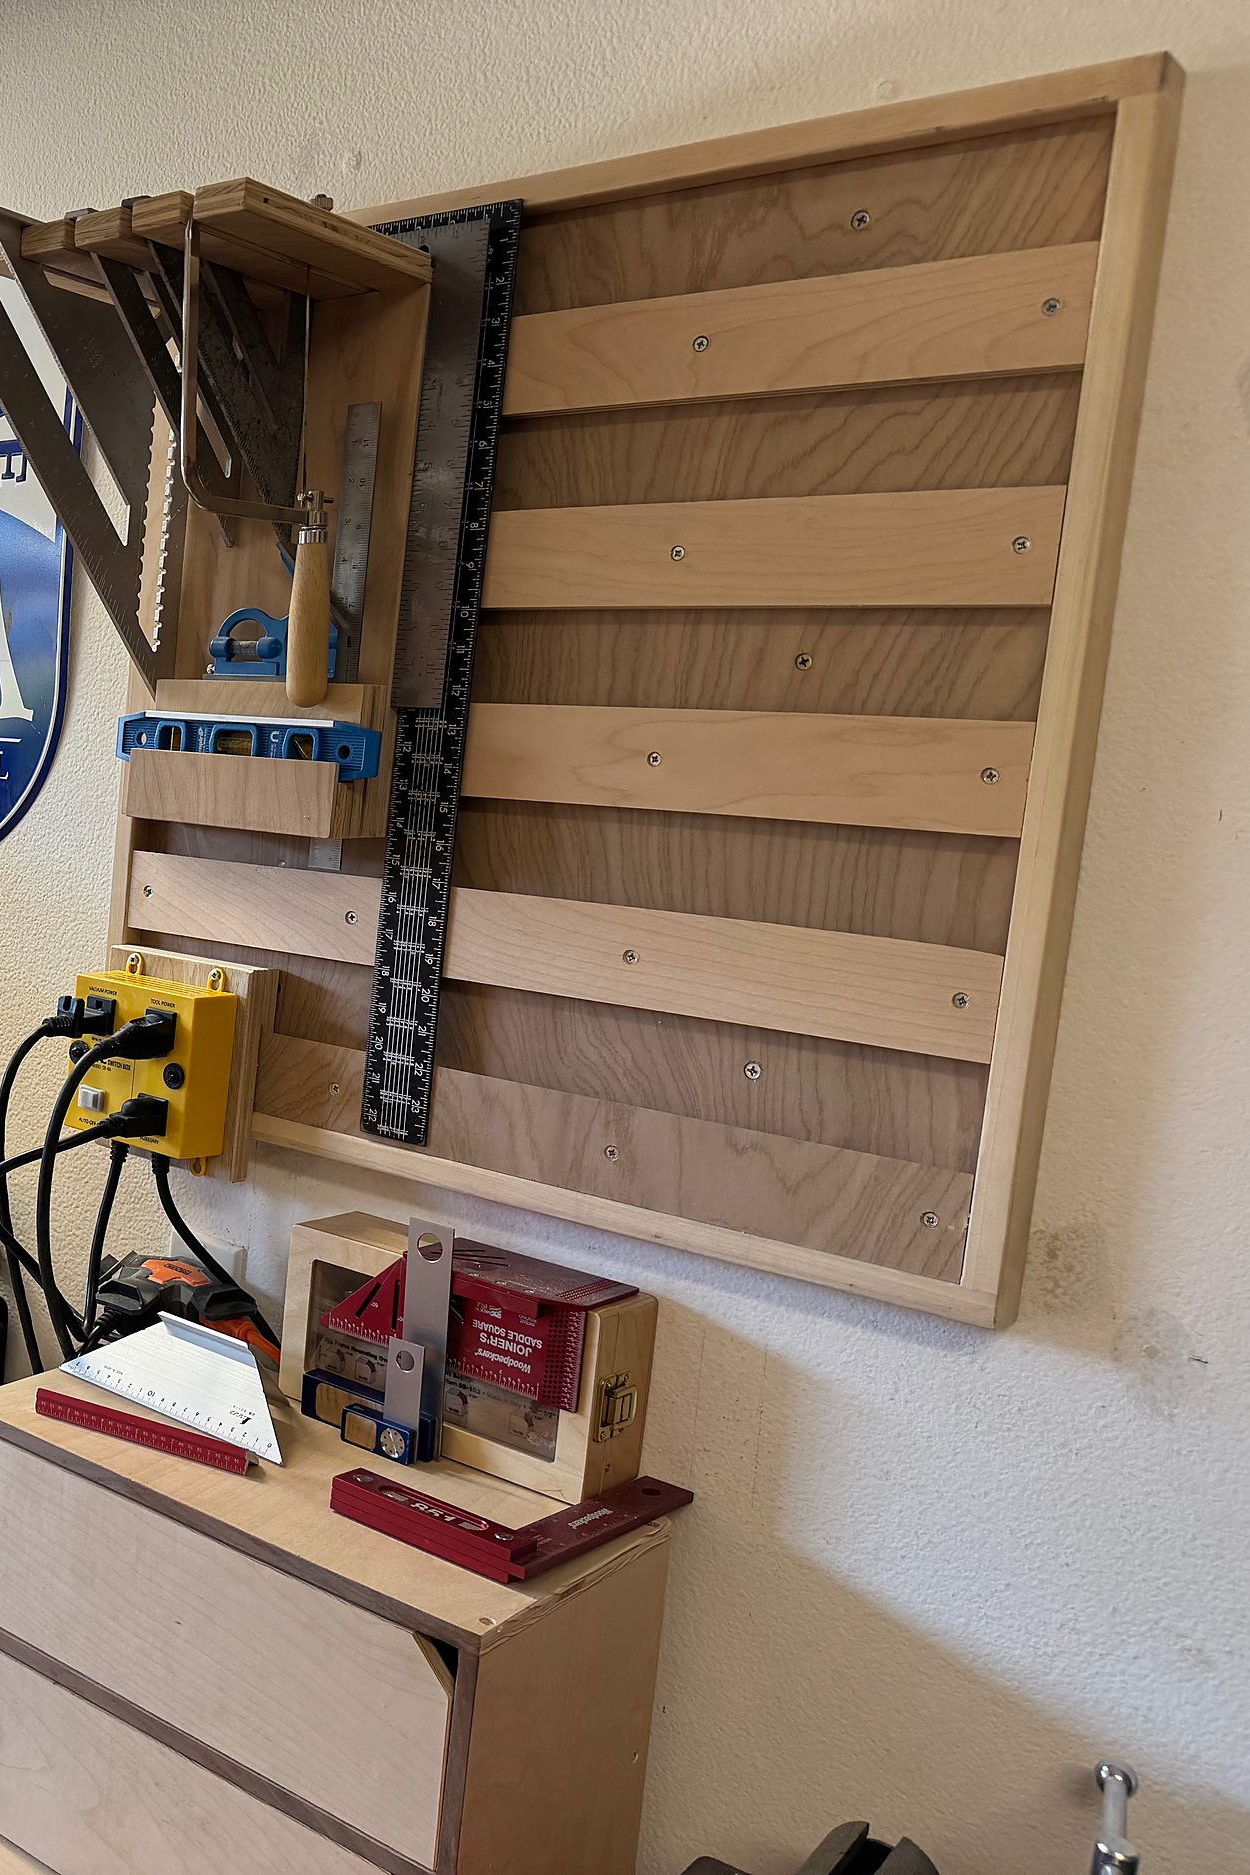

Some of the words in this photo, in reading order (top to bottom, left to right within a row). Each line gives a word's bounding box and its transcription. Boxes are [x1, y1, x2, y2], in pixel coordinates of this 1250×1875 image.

[460, 605, 470, 618] 10
[451, 684, 461, 697] 12
[447, 723, 457, 736] 13
[402, 741, 412, 753] 12
[443, 763, 453, 775] 14
[399, 779, 408, 791] 13
[439, 802, 449, 814] 15
[396, 817, 405, 828] 14
[435, 840, 445, 852] 16
[391, 854, 401, 866] 15
[431, 878, 441, 890] 17
[387, 891, 397, 903] 16
[427, 916, 437, 927] 18
[384, 928, 394, 941] 17
[424, 953, 434, 965] 19
[381, 965, 390, 977] 18
[104, 988, 118, 996] POWER
[421, 988, 431, 1003] 20
[150, 998, 161, 1006] TOOL
[161, 1001, 176, 1009] POWER
[378, 1002, 387, 1014] 19
[418, 1025, 427, 1037] 21
[374, 1036, 383, 1050] 20
[107, 1060, 123, 1069] SWITCH
[122, 1063, 132, 1072] BOX
[414, 1062, 424, 1077] 22
[371, 1072, 381, 1084] 21
[411, 1100, 421, 1114] 23
[368, 1108, 378, 1122] 22
[472, 1318, 507, 1337] SQUARE
[479, 1332, 533, 1357] JOINER'S
[507, 1330, 543, 1349] SADDLE
[476, 1347, 531, 1374] Woodpeckers
